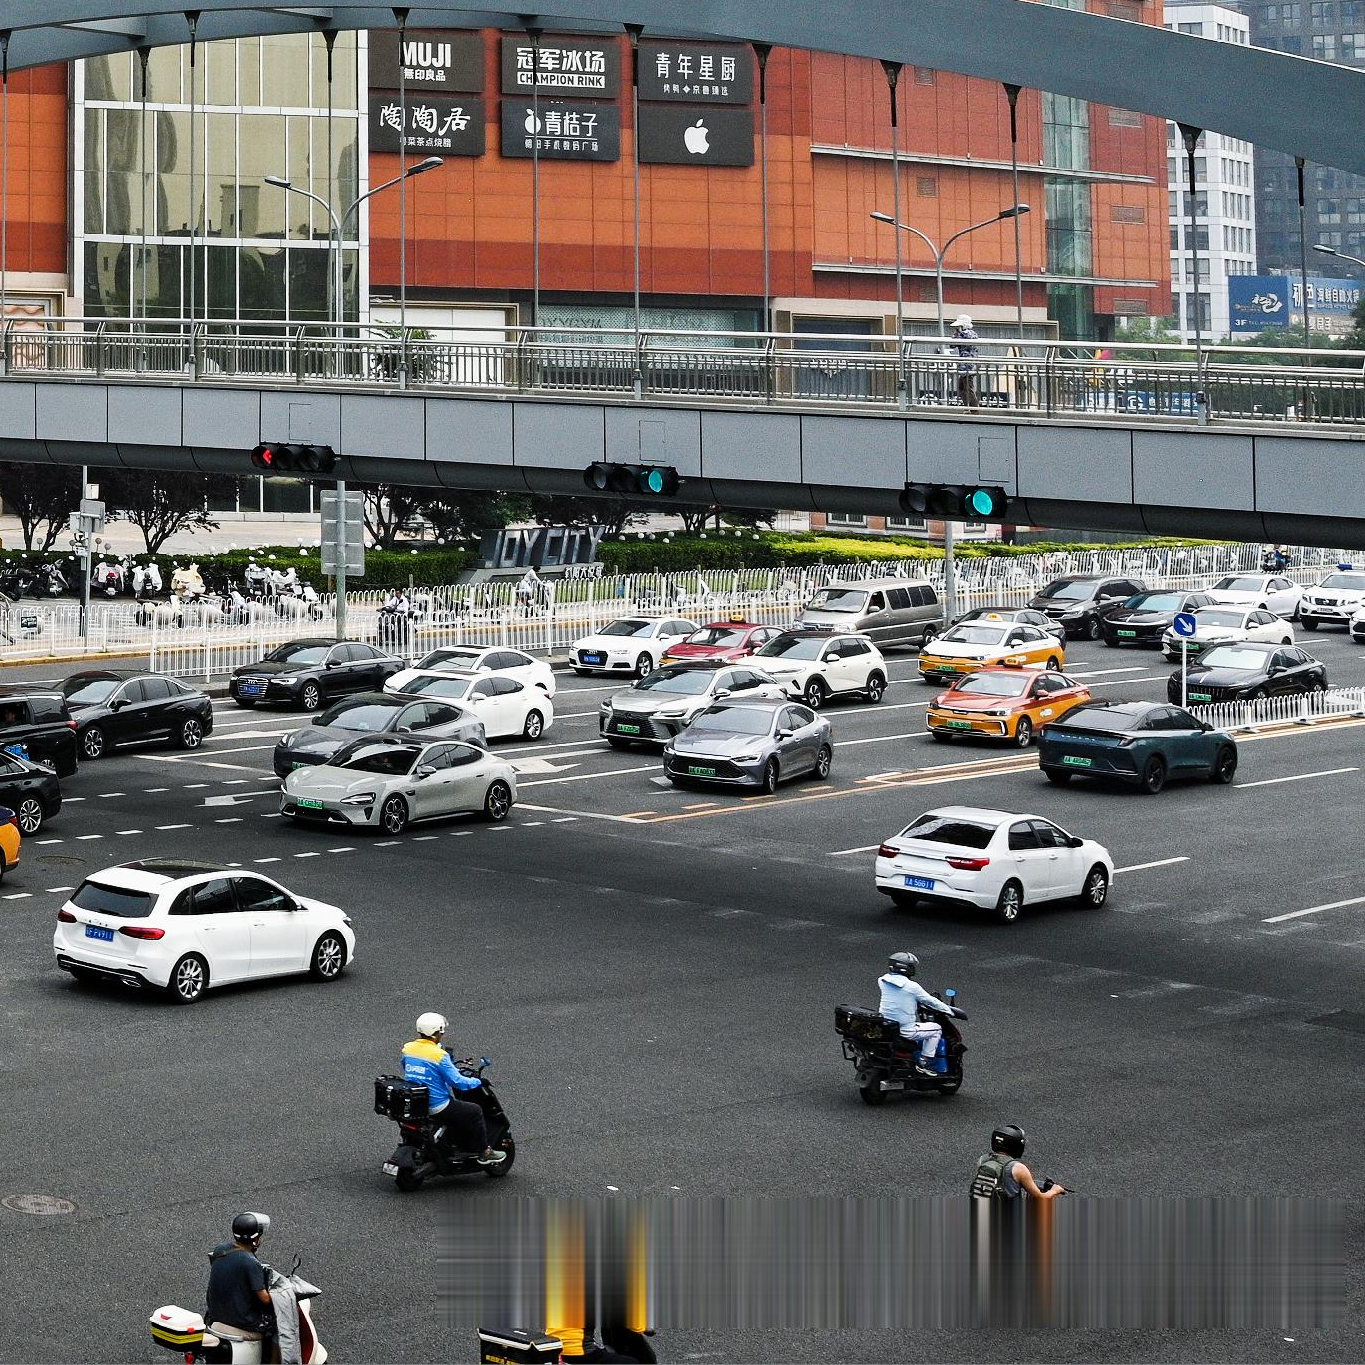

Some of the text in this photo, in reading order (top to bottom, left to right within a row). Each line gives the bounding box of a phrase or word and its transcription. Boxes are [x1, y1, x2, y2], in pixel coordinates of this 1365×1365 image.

[399, 41, 451, 67] MUJI
[517, 48, 605, 72] 冠军冰场
[656, 52, 735, 81] 青年星厨
[404, 67, 445, 81] 無印良品
[578, 76, 603, 87] RINK
[379, 103, 471, 136] 陶陶居
[545, 111, 598, 136] 青桔子
[485, 525, 605, 568] JOY CITY
